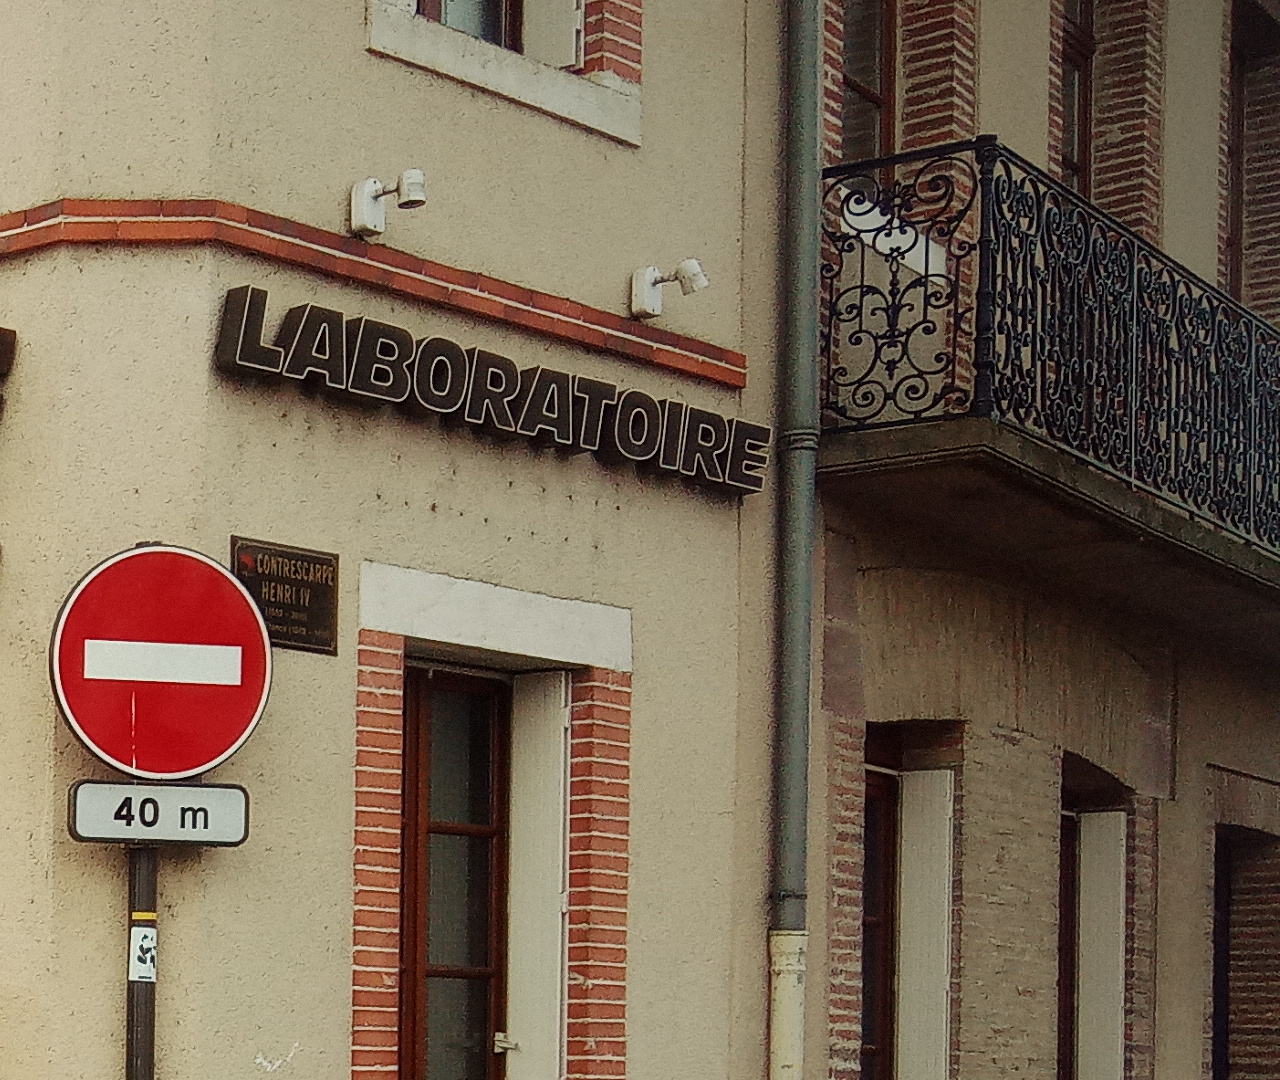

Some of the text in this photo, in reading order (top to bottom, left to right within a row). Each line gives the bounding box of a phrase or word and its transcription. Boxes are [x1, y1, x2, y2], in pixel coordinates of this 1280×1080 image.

[218, 285, 772, 494] LABORATOIRE
[257, 553, 335, 587] CONTRESCARPE
[261, 580, 311, 607] HENRI IV
[113, 798, 209, 830] 40 m
